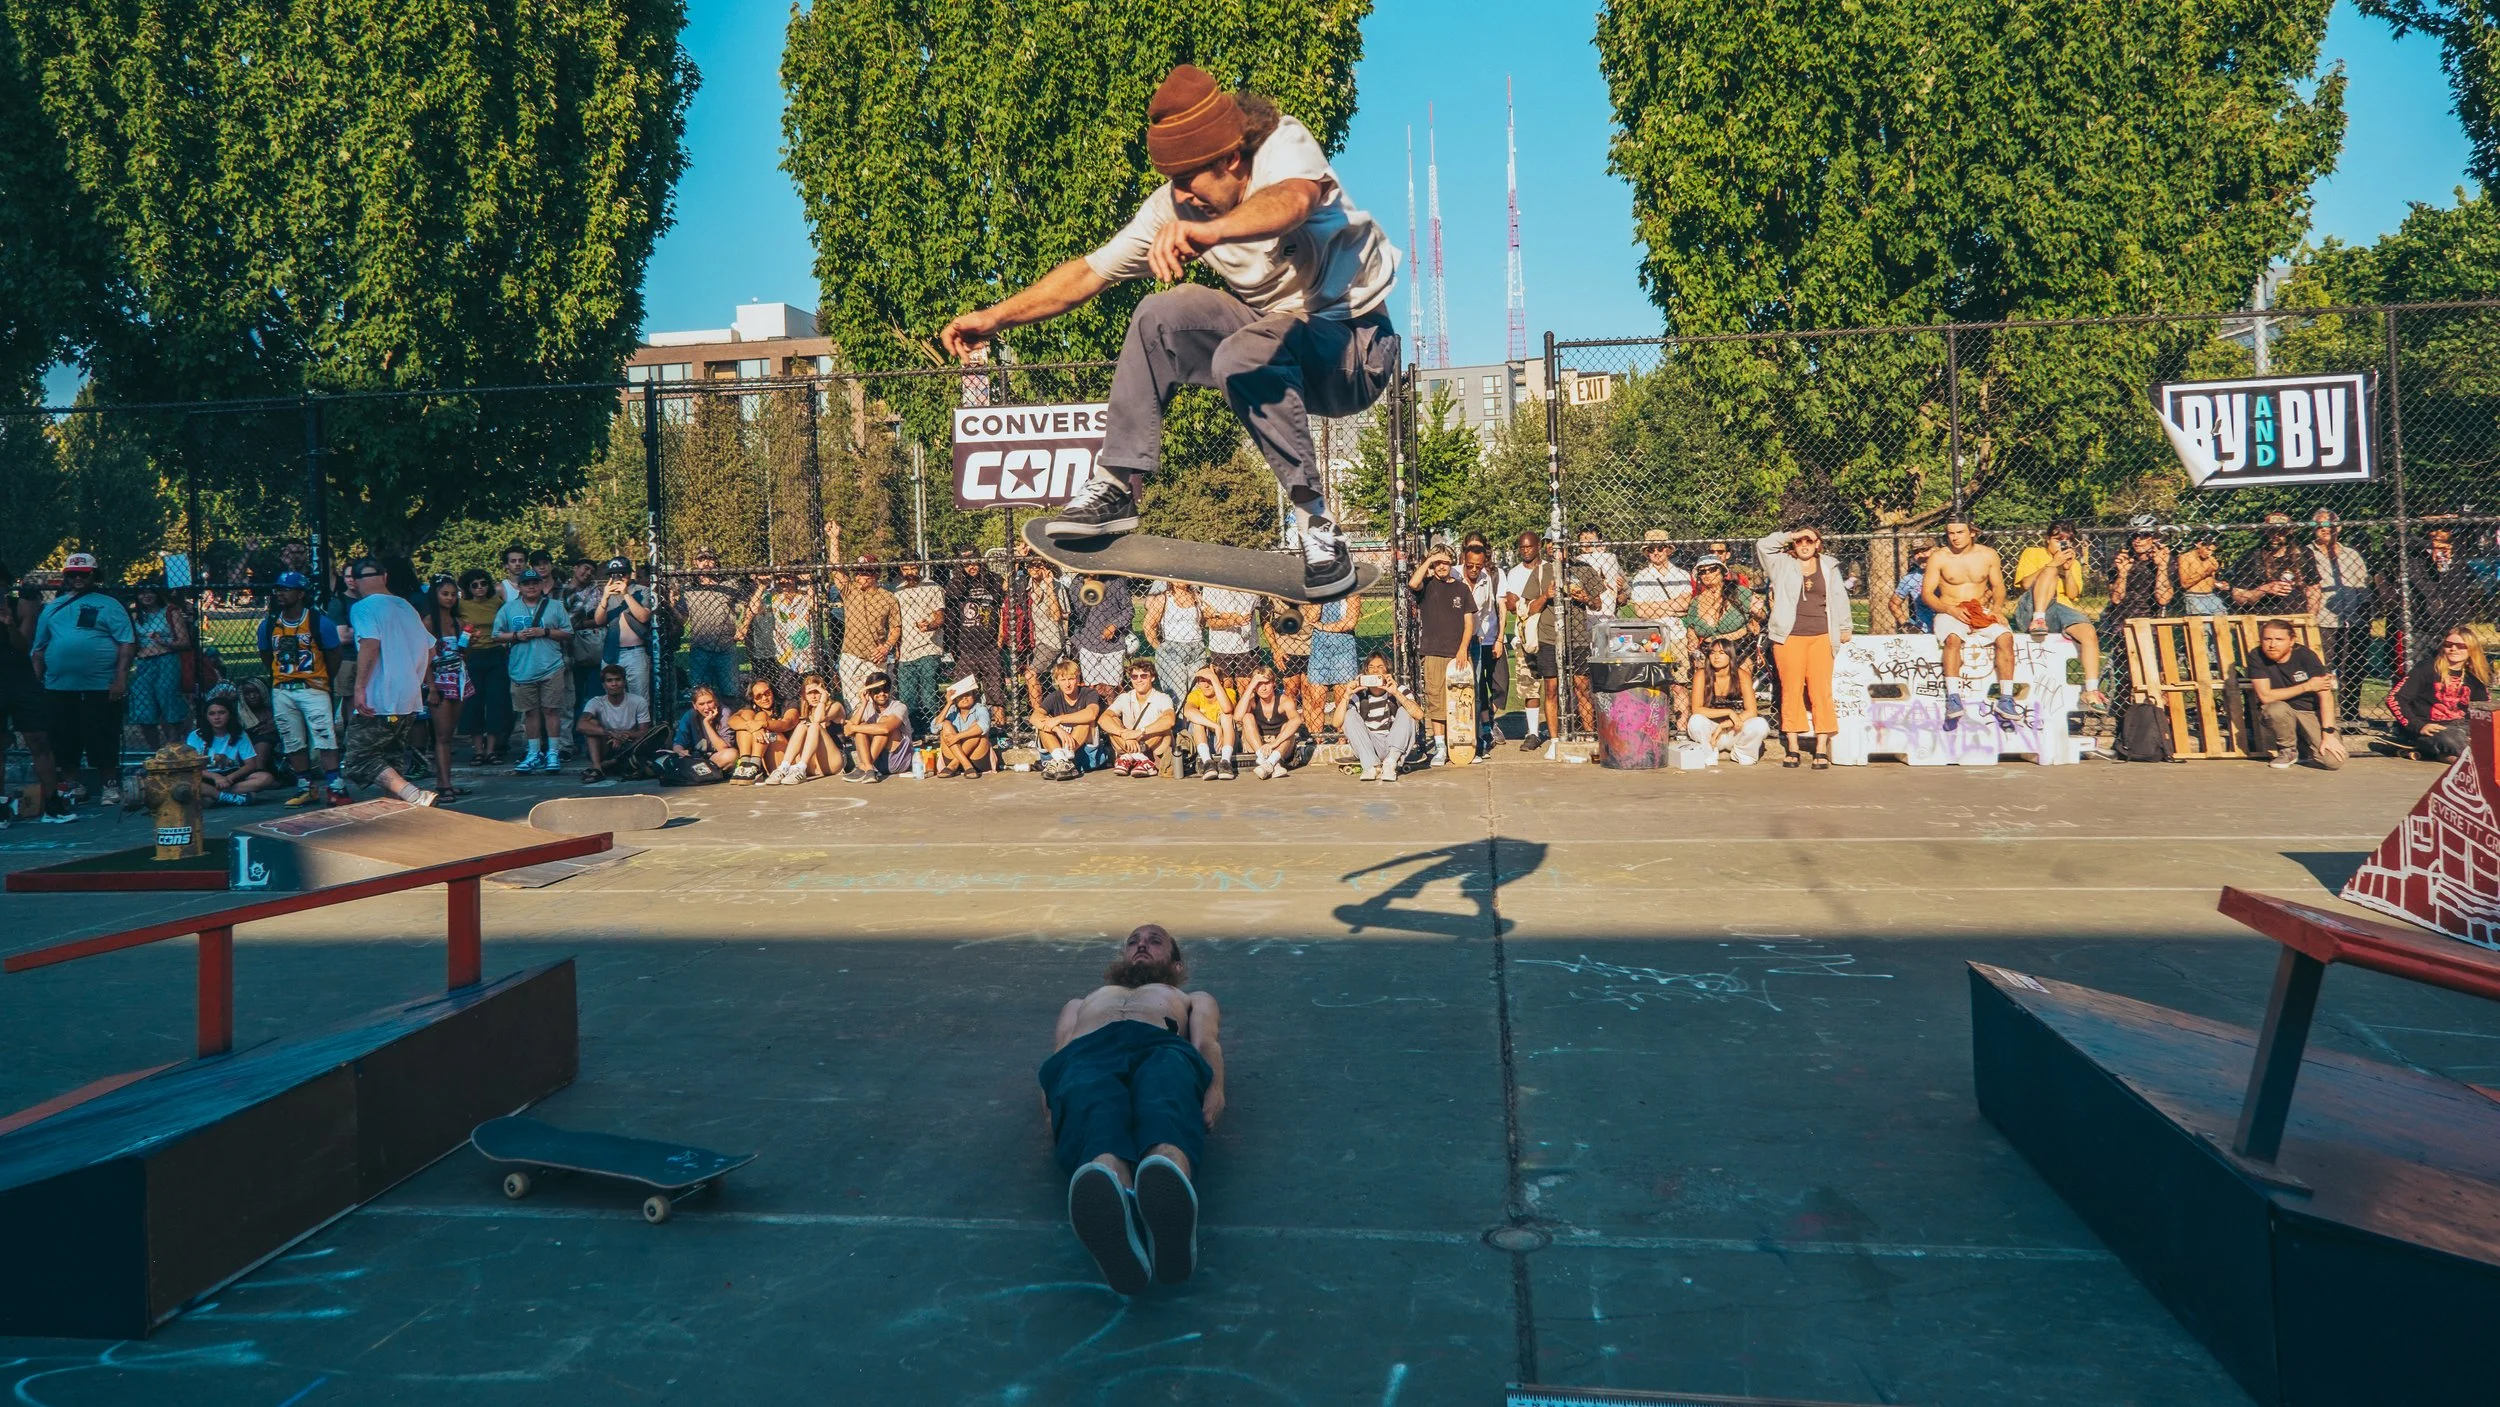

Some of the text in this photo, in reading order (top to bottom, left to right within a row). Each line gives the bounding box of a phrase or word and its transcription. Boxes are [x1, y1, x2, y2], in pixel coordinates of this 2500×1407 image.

[1577, 378, 1605, 401] EXIT
[961, 410, 1108, 436] CONVERS
[2181, 388, 2346, 472] BY AND BY
[962, 448, 1104, 500] CON
[2432, 799, 2500, 854] EVERETT CR
